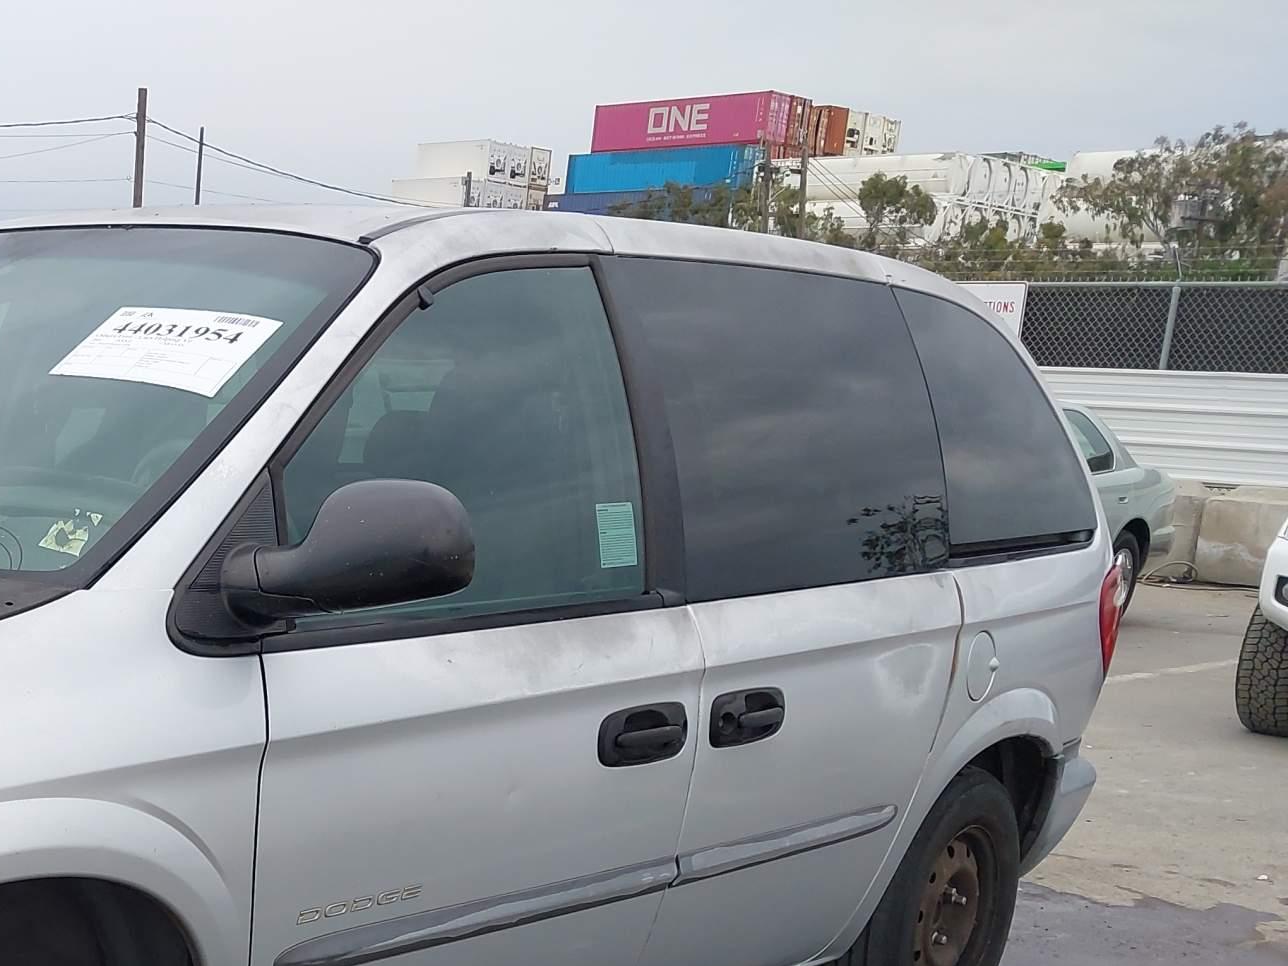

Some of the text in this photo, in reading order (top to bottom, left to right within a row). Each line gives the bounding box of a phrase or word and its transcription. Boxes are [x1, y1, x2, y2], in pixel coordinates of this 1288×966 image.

[647, 103, 710, 133] ONE
[983, 301, 1016, 313] TIONS
[113, 321, 244, 344] 44031954
[296, 884, 423, 926] DODGE
